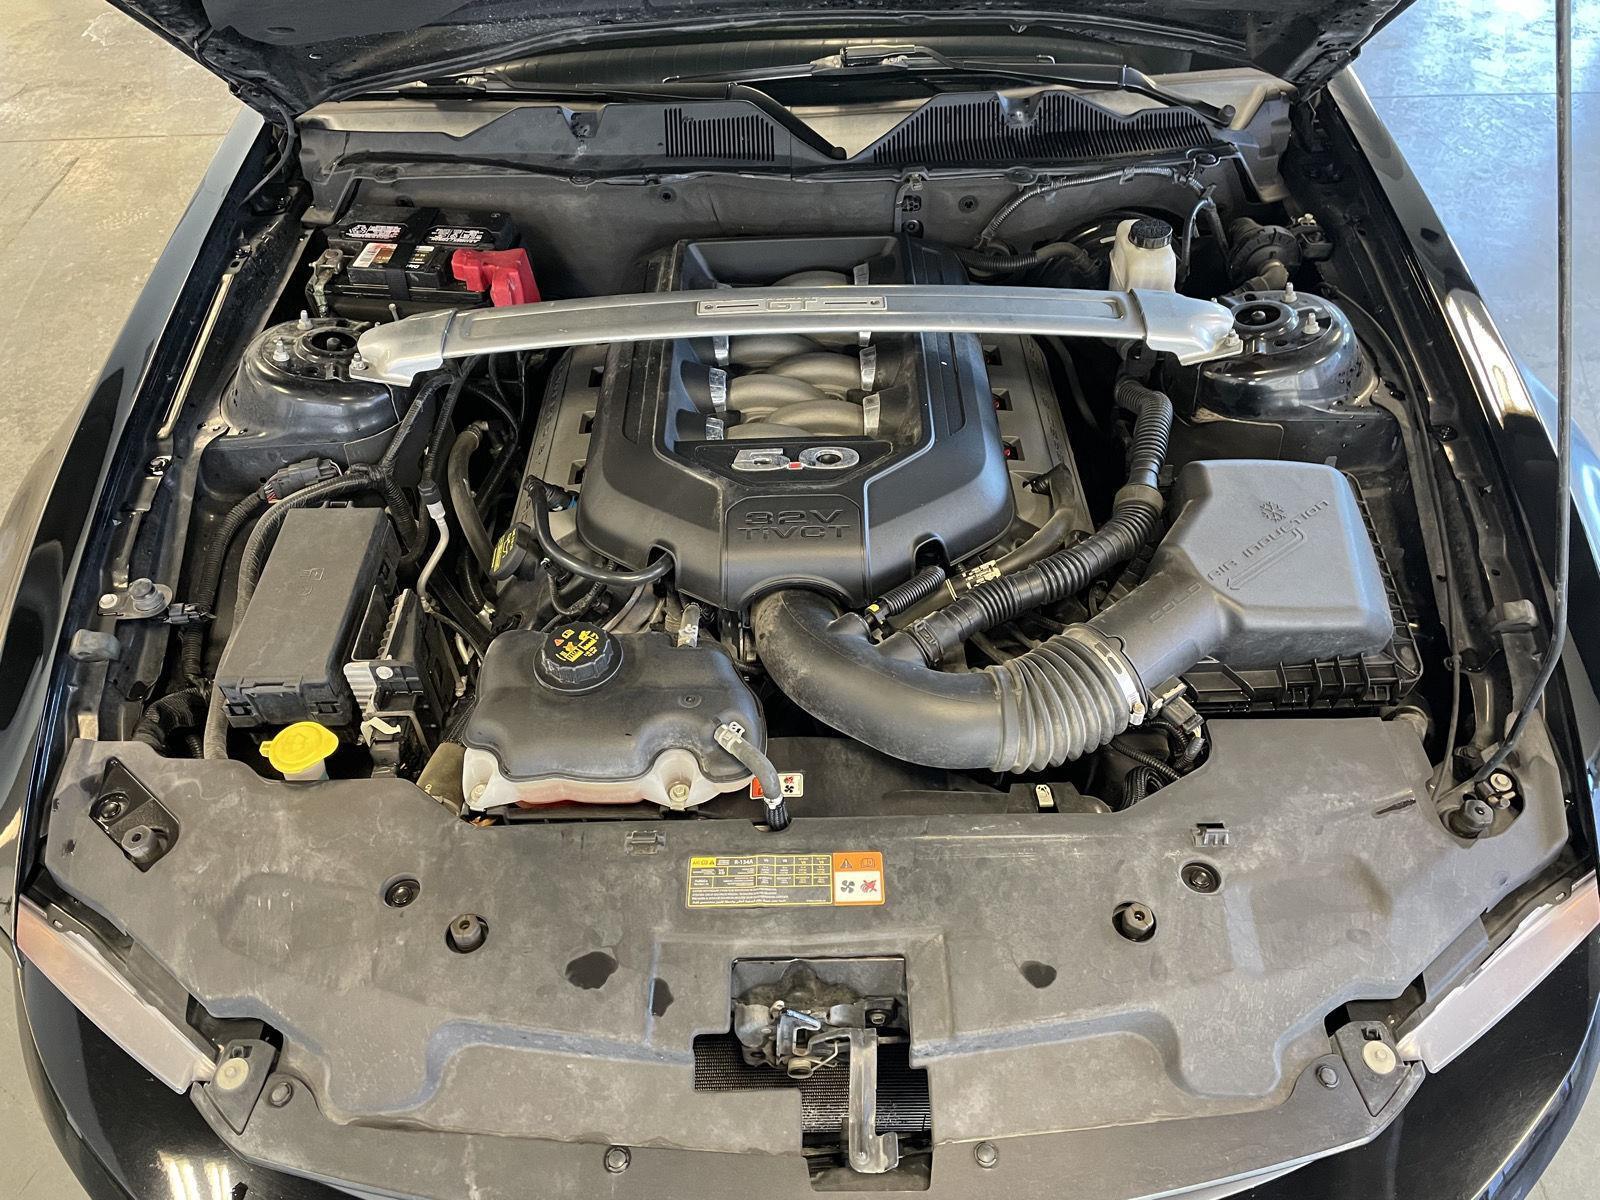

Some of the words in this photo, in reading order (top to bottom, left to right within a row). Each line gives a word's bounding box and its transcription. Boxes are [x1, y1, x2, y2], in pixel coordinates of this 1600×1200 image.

[767, 299, 817, 311] GT
[731, 446, 860, 472] 5.0
[745, 509, 843, 525] 32V
